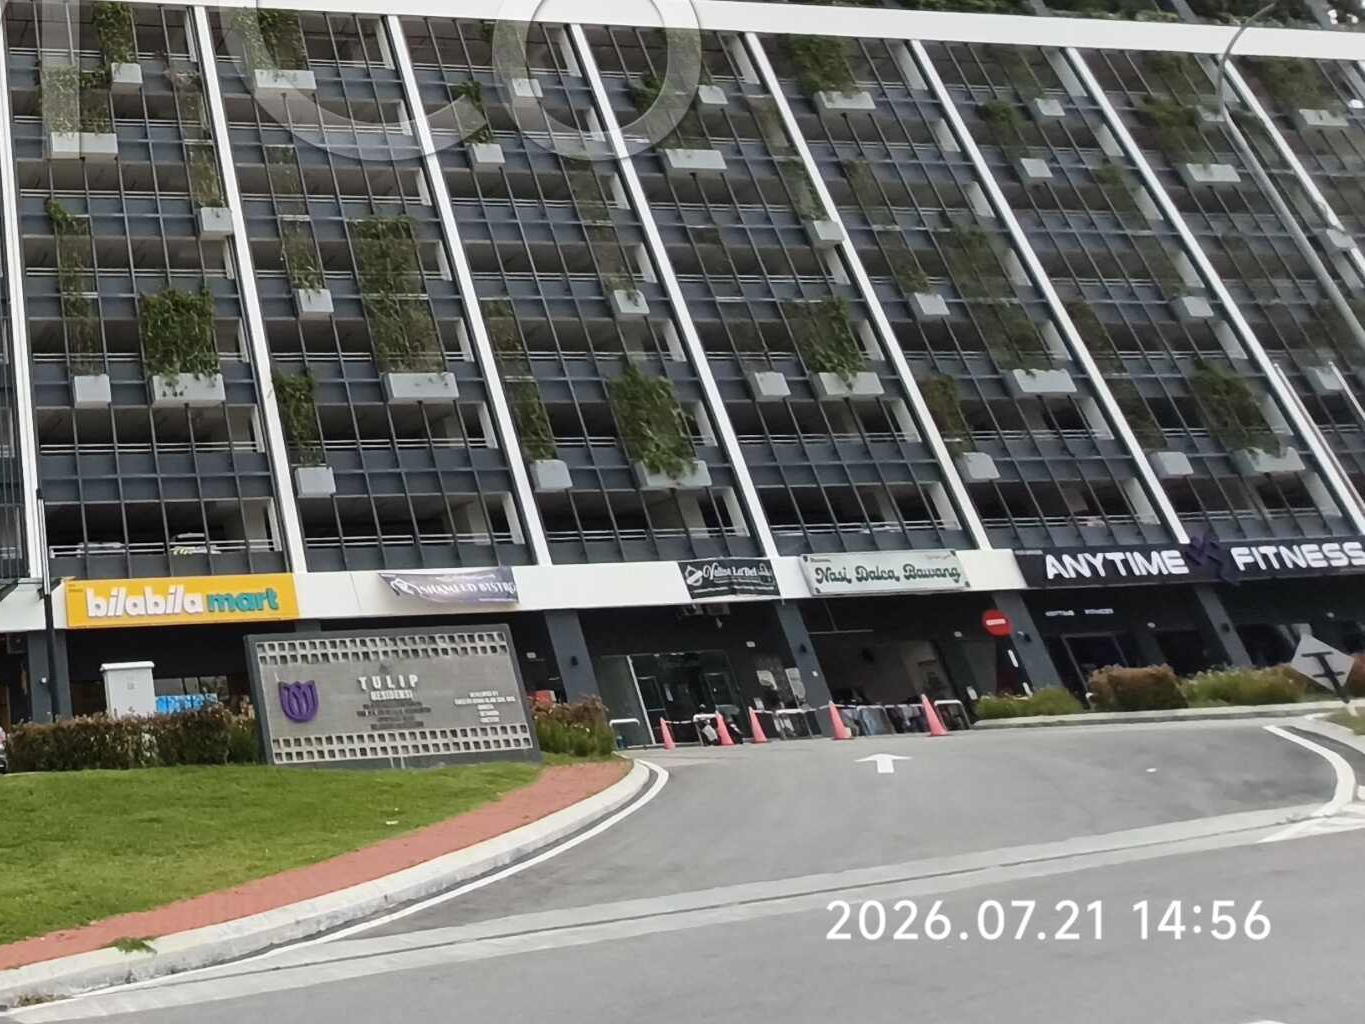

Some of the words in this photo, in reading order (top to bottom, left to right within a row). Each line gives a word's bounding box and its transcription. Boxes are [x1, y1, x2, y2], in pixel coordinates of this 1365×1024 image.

[814, 566, 852, 584] Nasi
[855, 565, 900, 582] Dalca
[902, 563, 961, 583] Bawang
[1045, 550, 1190, 579] ANYTIME
[1230, 542, 1365, 571] FITNESS
[86, 584, 204, 618] bilabila
[206, 588, 279, 612] mart
[359, 674, 418, 691] TULIP
